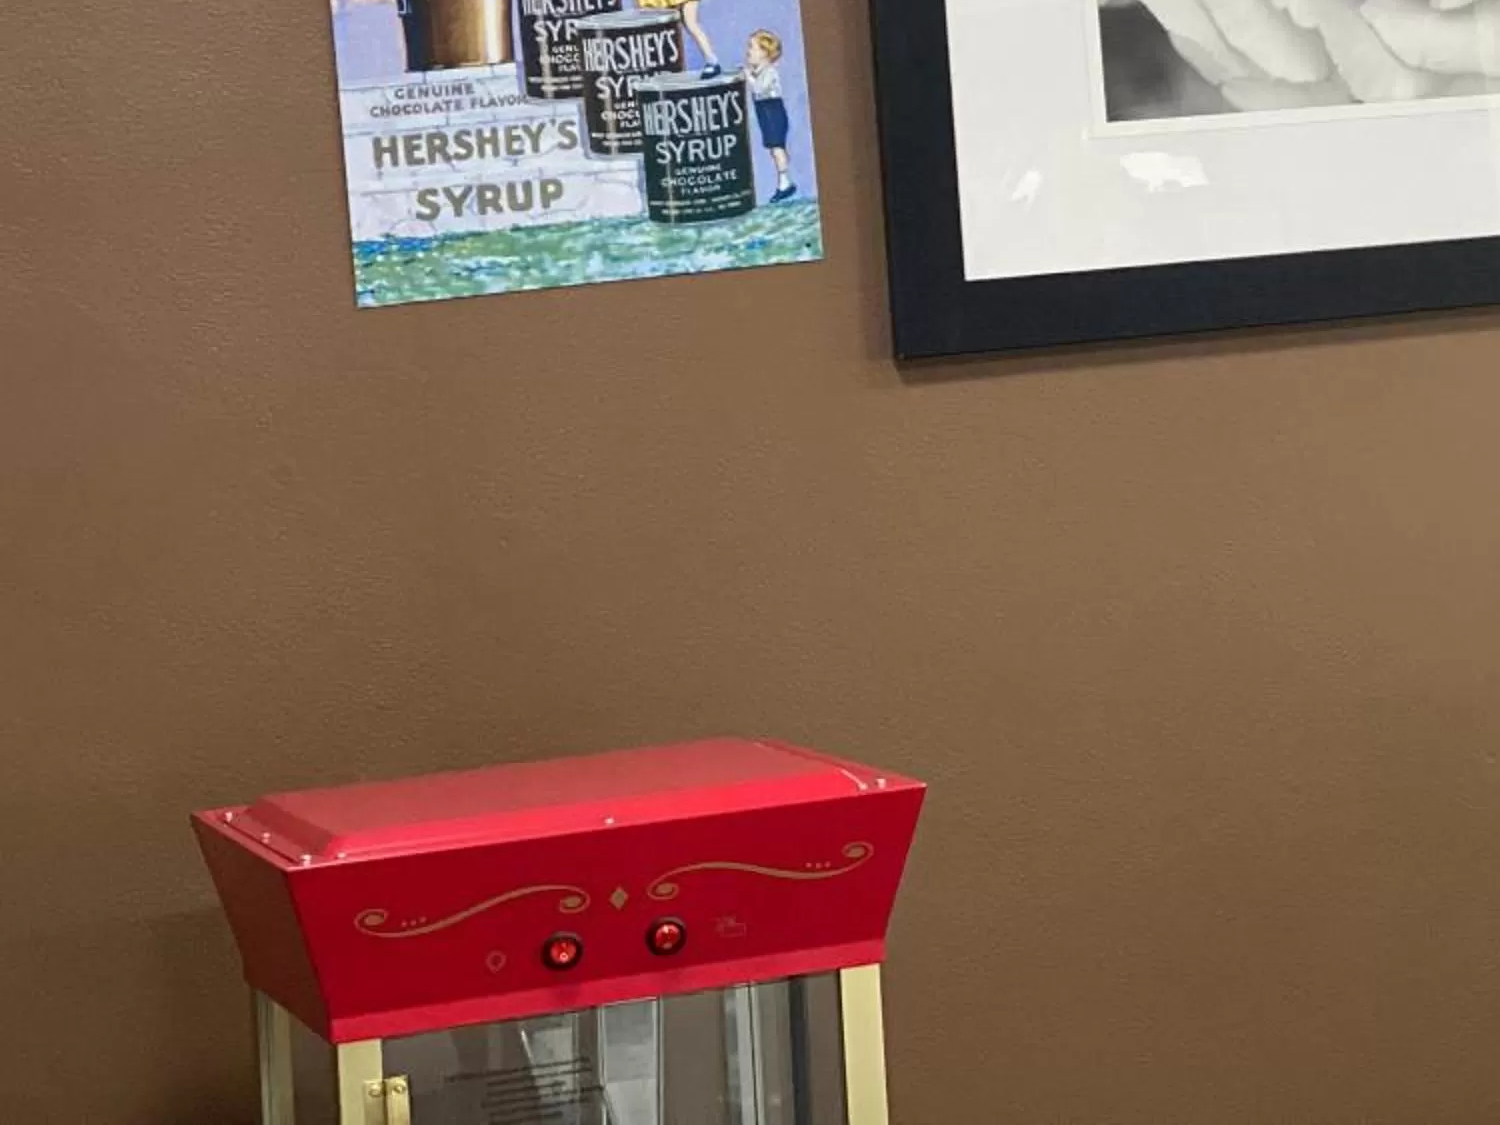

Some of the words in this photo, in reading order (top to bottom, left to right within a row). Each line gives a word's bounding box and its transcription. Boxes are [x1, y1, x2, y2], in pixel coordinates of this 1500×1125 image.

[394, 82, 476, 100] GENUINE
[370, 99, 464, 119] CHOCOLATE
[372, 119, 579, 169] HERSHEY'S
[655, 134, 738, 165] SYRUP
[415, 178, 565, 222] SYRUP
